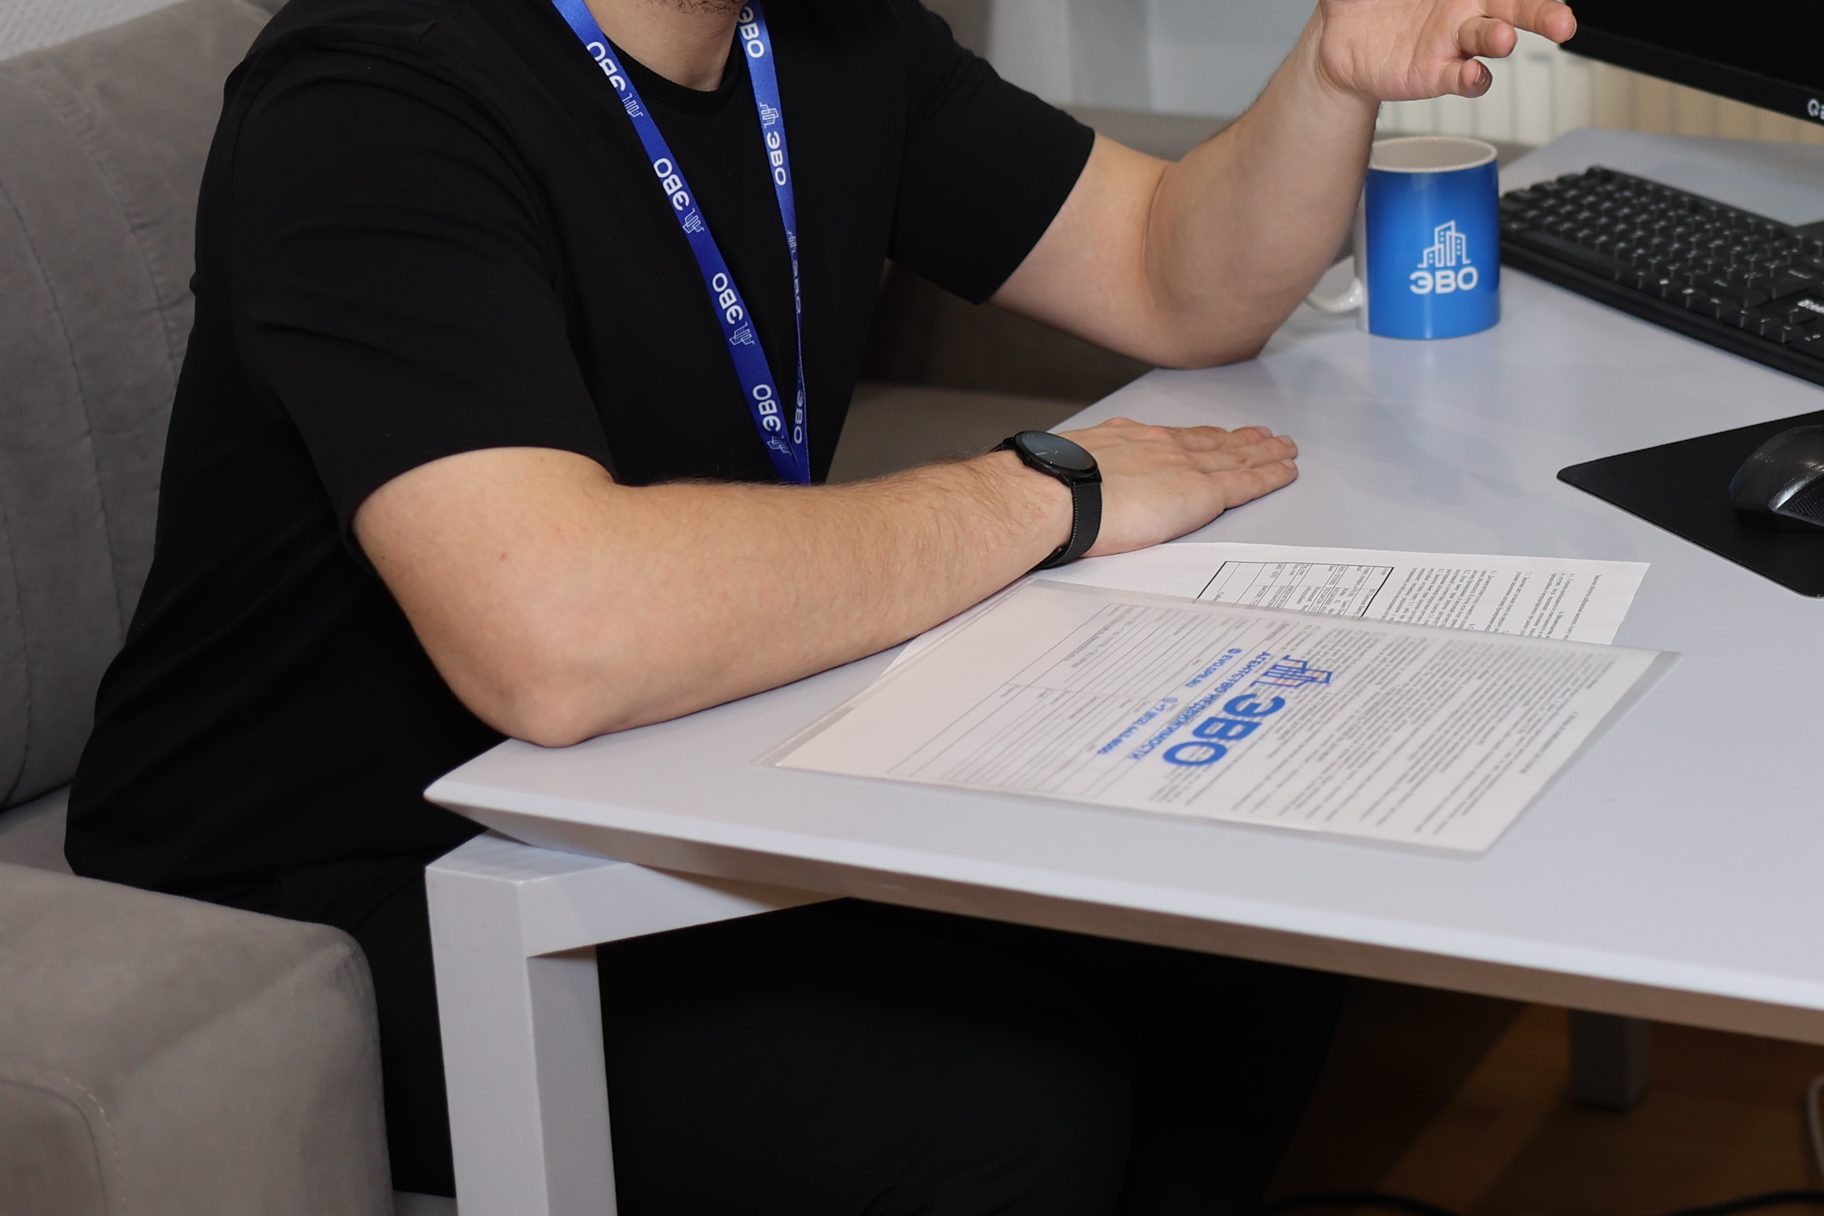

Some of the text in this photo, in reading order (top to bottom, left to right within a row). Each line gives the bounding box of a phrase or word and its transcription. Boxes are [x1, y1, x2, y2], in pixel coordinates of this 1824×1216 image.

[738, 6, 765, 58] ЭВО
[653, 157, 690, 211] ЭВО
[766, 131, 787, 186] ЭВО
[712, 272, 744, 325] ЭВО
[1409, 266, 1479, 295] ЭВО
[753, 384, 782, 432] ЭВО
[1213, 651, 1271, 694] АГЕНТСТВО
[1162, 693, 1286, 766] ЭВО
